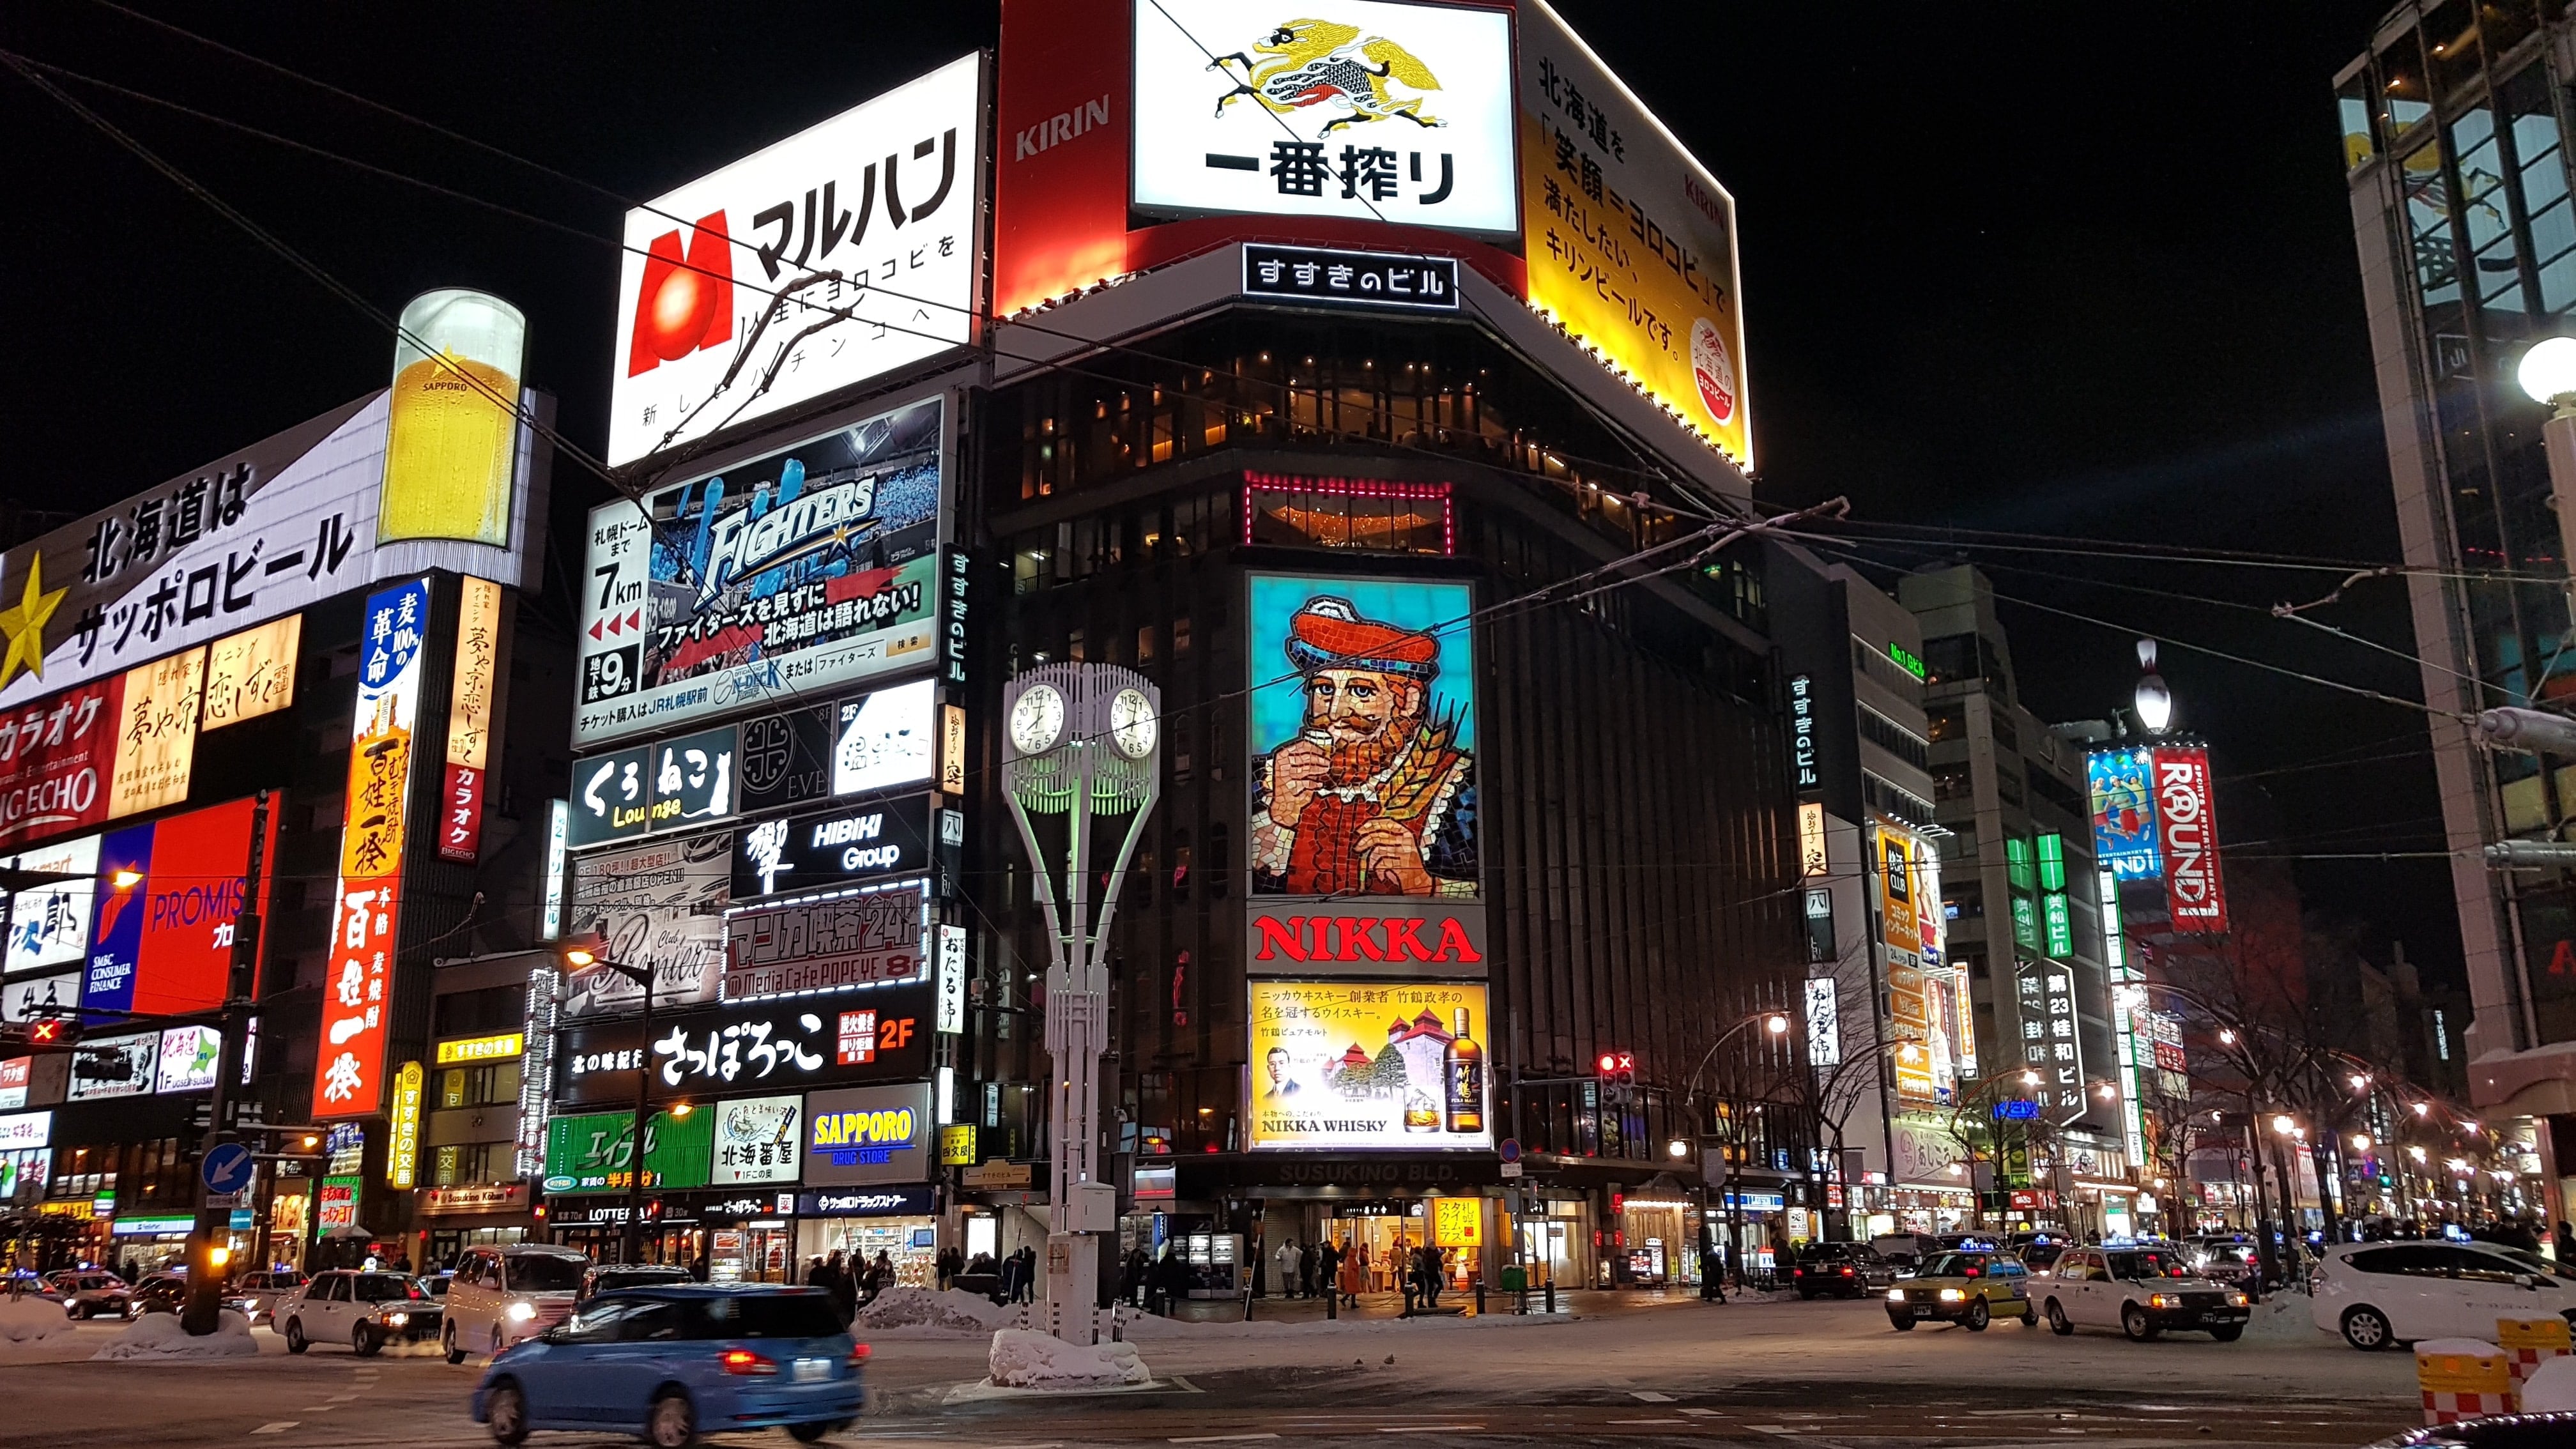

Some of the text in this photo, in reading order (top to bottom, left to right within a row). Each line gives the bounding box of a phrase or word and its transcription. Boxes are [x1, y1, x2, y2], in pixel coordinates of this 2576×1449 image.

[1015, 93, 1110, 163] KIRIN
[1538, 56, 1625, 165] 北海道を
[1206, 141, 1453, 204] 一番搾り
[753, 127, 956, 282] マルハン
[1683, 173, 1724, 230] KIRIN
[1257, 259, 1444, 297] すすきのビル
[1546, 227, 1679, 362] キリンビールです。
[422, 381, 468, 392] SAPPORO
[83, 462, 251, 586] 北海道は
[594, 515, 649, 546] 札幌ドーム
[611, 541, 631, 557] まで
[693, 473, 878, 611] FIGHTERS
[73, 512, 355, 669] サッポロビール
[657, 582, 825, 650] ファイターズを見ずに
[950, 553, 970, 682] すすきのビル
[367, 608, 394, 683] 革命
[818, 645, 877, 670] ファイターズ
[898, 634, 919, 650] 検索
[588, 657, 601, 699] 地下鉄
[786, 659, 813, 679] または
[841, 703, 858, 722] 2F
[1792, 677, 1816, 785] すすきのビル
[0, 789, 24, 827] IG
[26, 767, 96, 813] ECHO
[585, 747, 708, 816] くろねこ
[788, 774, 828, 799] EVE
[450, 768, 474, 844] カラオケ
[613, 797, 681, 827] Lounge
[813, 813, 883, 848] HIBIKI
[2161, 762, 2220, 916] ROUND1
[843, 845, 900, 870] Group
[152, 878, 245, 932] PROMIS
[1252, 916, 1482, 962] NIKKA
[91, 963, 131, 981] CONSUMER
[93, 954, 114, 967] SMBC
[821, 957, 880, 985] POPEYE
[89, 978, 121, 993] FINANCE
[1397, 990, 1462, 1003] 竹鶴政孝の
[654, 1013, 824, 1086] さっぽろっこ
[879, 1018, 915, 1050] 2F
[159, 1070, 172, 1090] 1F
[397, 1088, 418, 1185] すすきの交番
[815, 1110, 912, 1145] SAPPORO
[1262, 1120, 1387, 1132] NIKKA WHISKY
[722, 1141, 793, 1167] 北海番屋
[832, 1149, 890, 1166] DRUG STORE
[1279, 1163, 1399, 1183] SUSUKINO
[448, 1192, 480, 1203] Susukino
[589, 1208, 645, 1221] LOTTEA
[1440, 1202, 1449, 1242] スクエア
